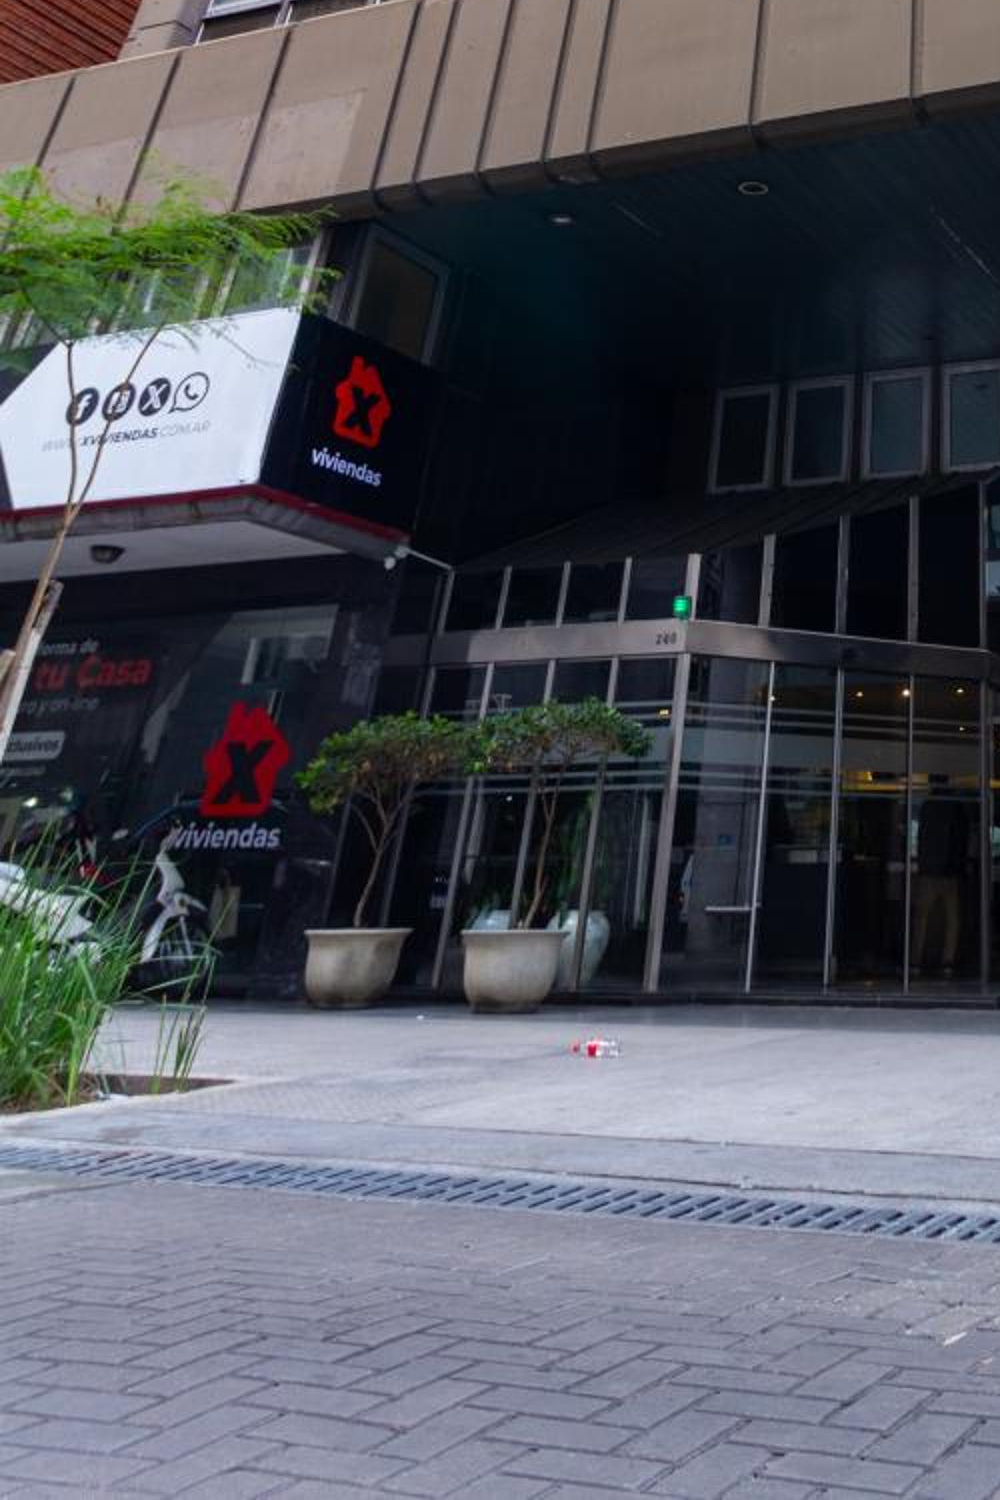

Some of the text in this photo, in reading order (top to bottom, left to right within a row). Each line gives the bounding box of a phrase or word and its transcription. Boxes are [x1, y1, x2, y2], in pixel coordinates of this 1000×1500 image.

[311, 447, 382, 486] viviendas
[77, 655, 152, 687] Casa
[174, 821, 281, 848] viviendas
